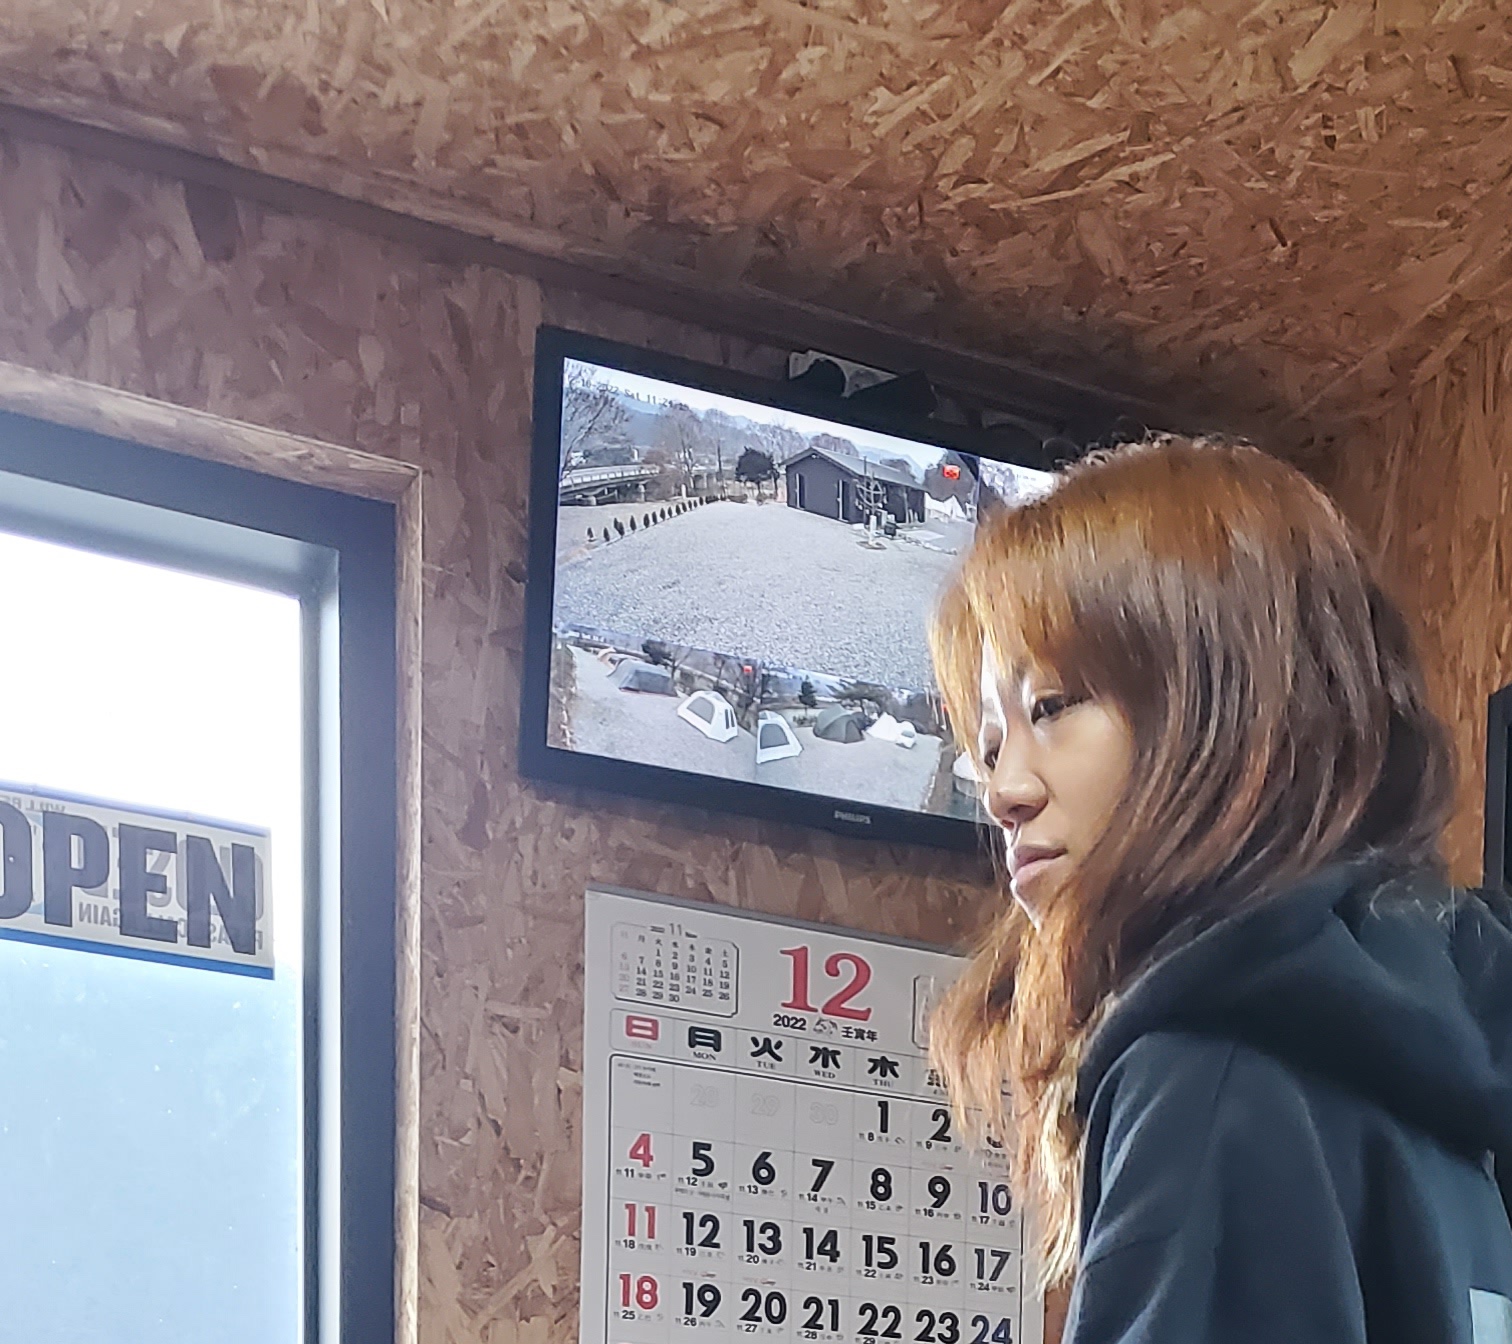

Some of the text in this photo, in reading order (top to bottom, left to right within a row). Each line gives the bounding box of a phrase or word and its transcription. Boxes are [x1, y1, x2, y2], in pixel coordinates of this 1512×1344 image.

[0, 801, 255, 955] OPEN
[779, 945, 872, 1021] 12
[625, 1015, 899, 1078] 日 月 火 水 木
[773, 1014, 878, 1042] 2022 壬寅年
[693, 1051, 716, 1061] MON
[756, 1060, 776, 1070] TUE
[814, 1070, 836, 1079] WED
[877, 1101, 889, 1133] 1
[930, 1109, 952, 1142] 2
[629, 1133, 1012, 1215] 4 5 6 7 8 9 10
[625, 1203, 1011, 1281] 11 12 13 14 15 16 17
[619, 1274, 658, 1310] 18
[683, 1282, 721, 1317] 19
[739, 1288, 786, 1324] 20
[801, 1296, 839, 1331] 21
[857, 1303, 902, 1338] 22
[914, 1309, 960, 1344] 23
